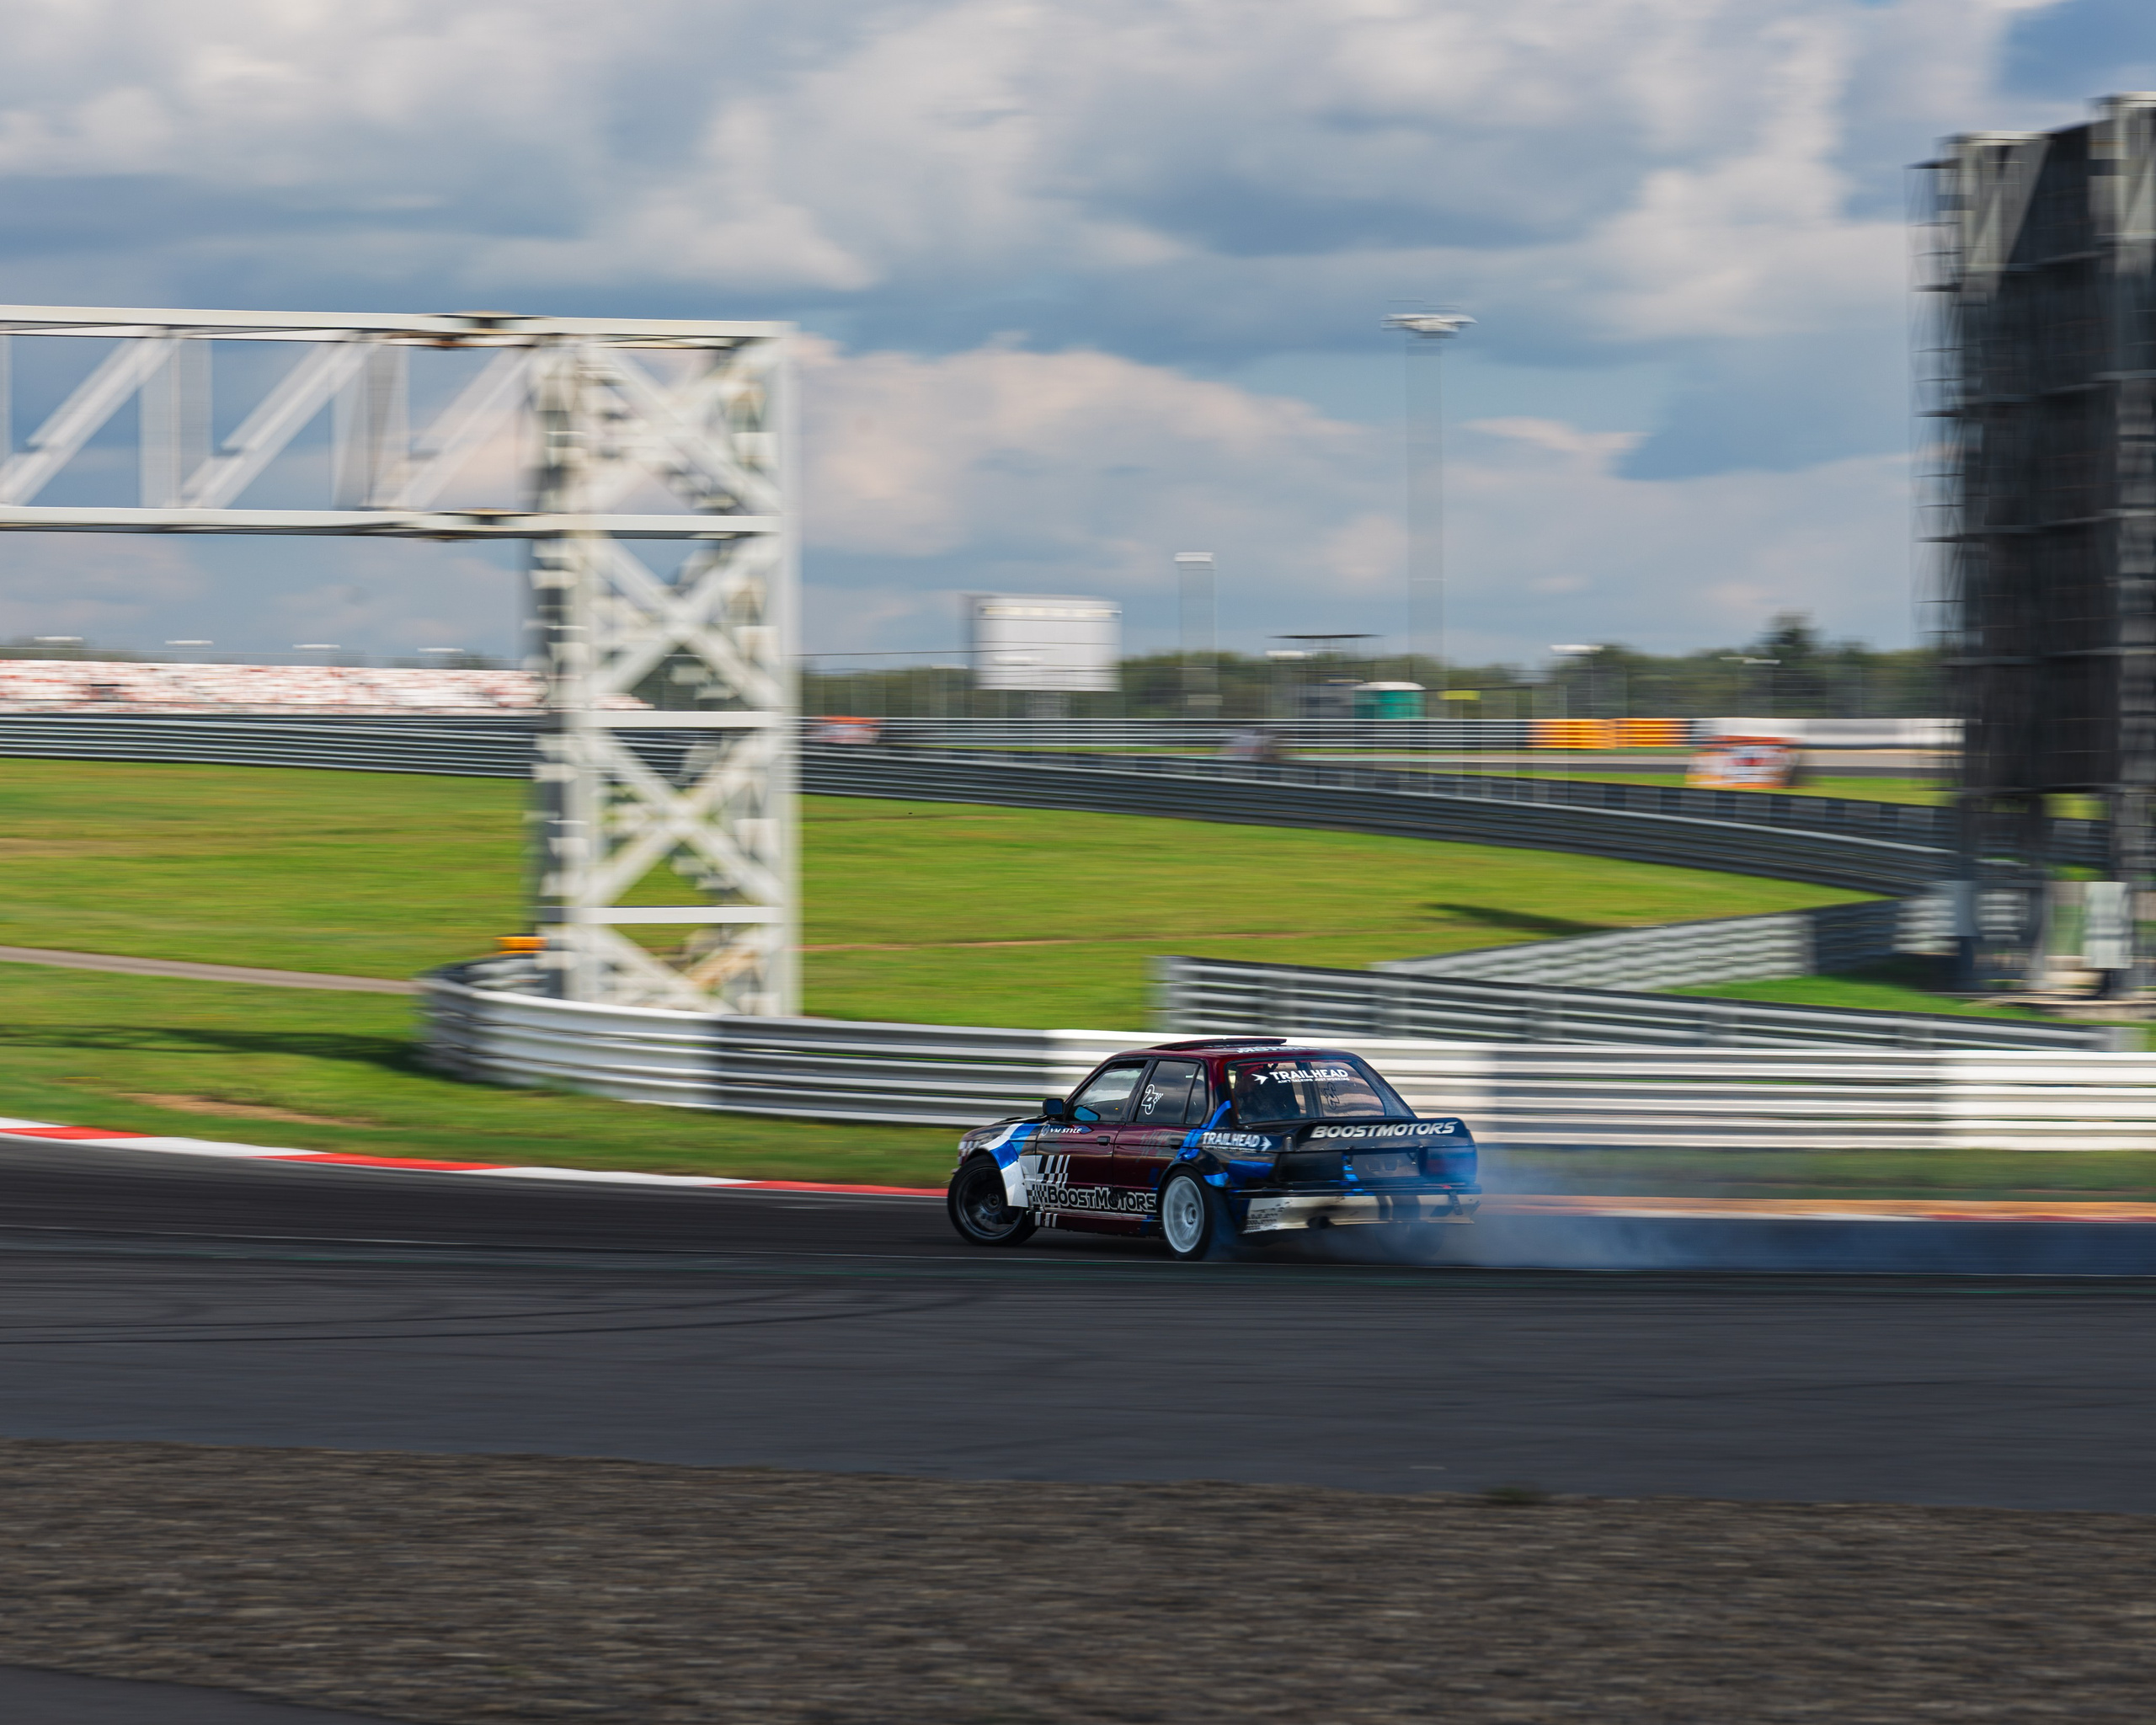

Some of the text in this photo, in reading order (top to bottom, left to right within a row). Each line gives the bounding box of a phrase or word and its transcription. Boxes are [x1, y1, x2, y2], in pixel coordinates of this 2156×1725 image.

[1269, 1069, 1348, 1080] TRAILHEAD
[1310, 1121, 1459, 1138] BOOSTMOTORS
[1202, 1132, 1261, 1147] TRAILHEAD
